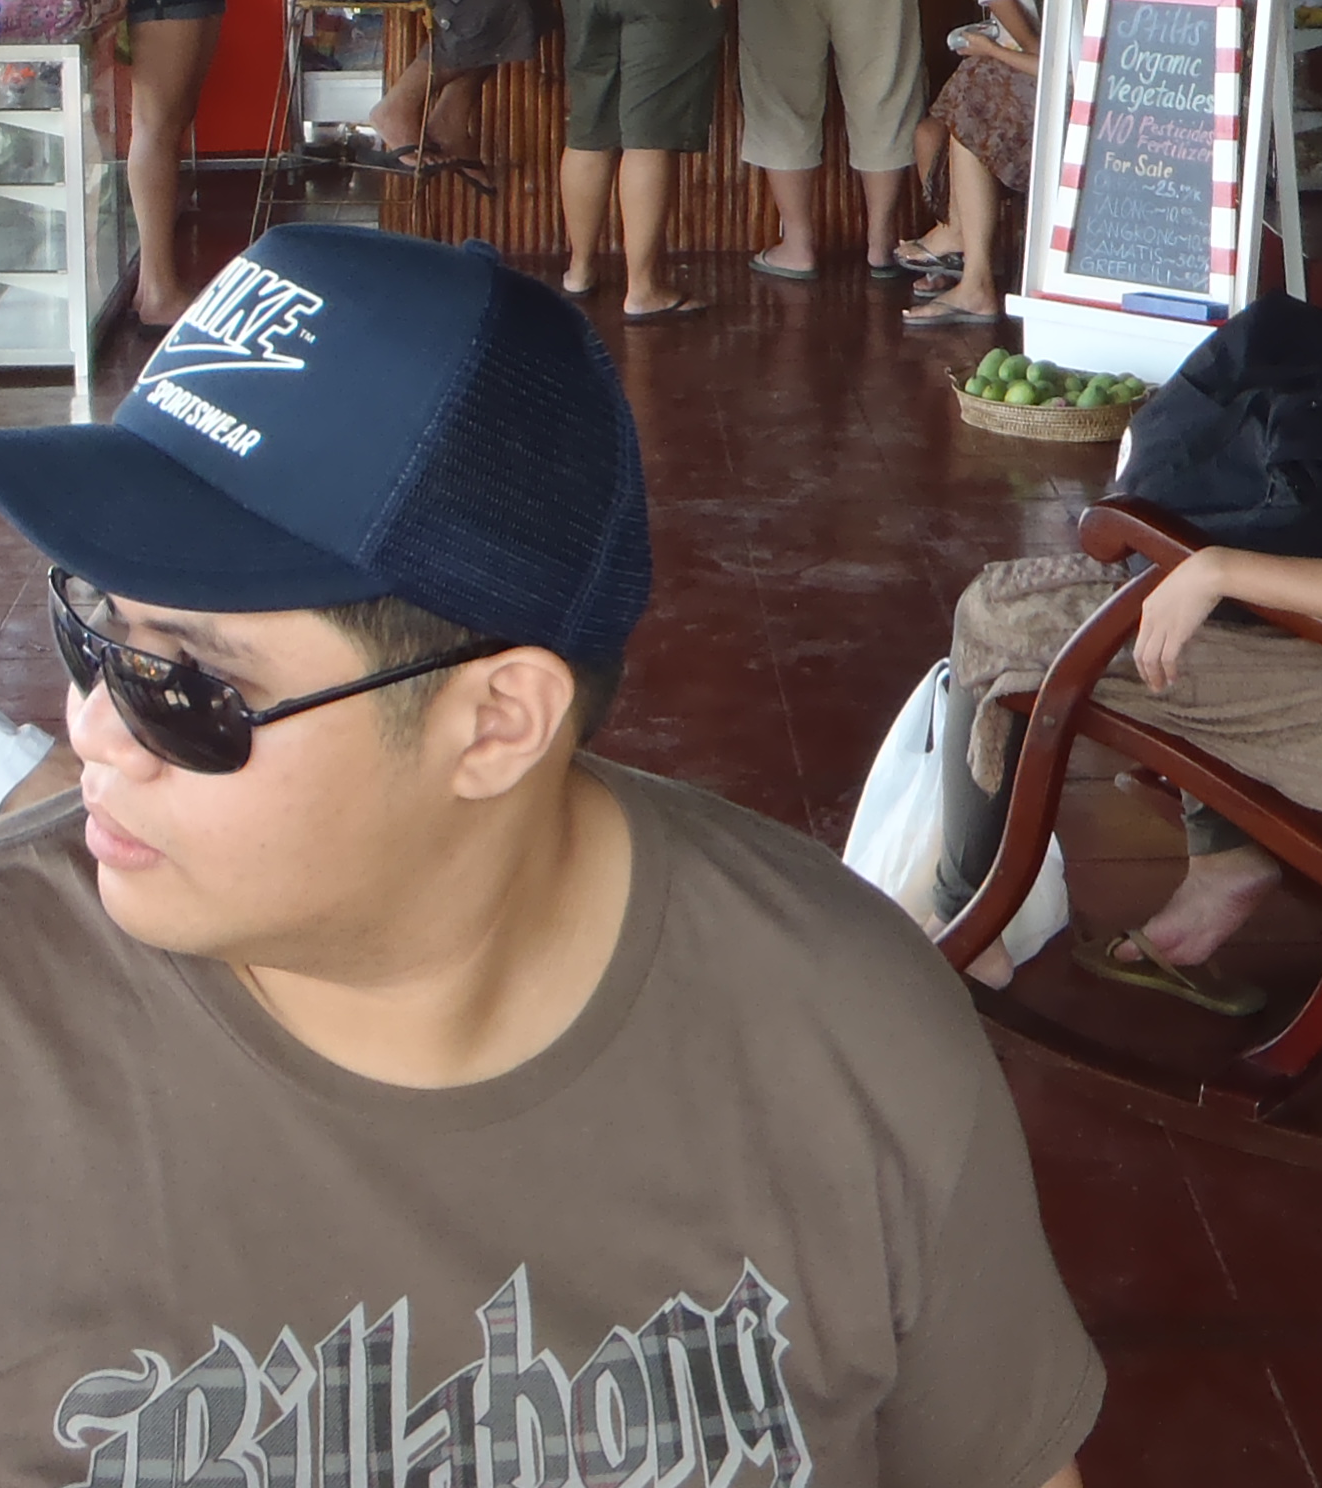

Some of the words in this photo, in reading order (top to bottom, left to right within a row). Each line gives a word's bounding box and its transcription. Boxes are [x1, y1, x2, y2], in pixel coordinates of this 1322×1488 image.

[1117, 4, 1209, 46] Stilts
[1120, 40, 1203, 85] Organic
[1107, 74, 1215, 114] Vegetables
[1097, 110, 1135, 145] NO
[1138, 115, 1215, 146] Pesticides
[1104, 151, 1131, 174] For
[1134, 153, 1173, 179] Sale
[146, 379, 261, 457] SPORTSWEAR
[51, 1256, 814, 1488] Billabong
